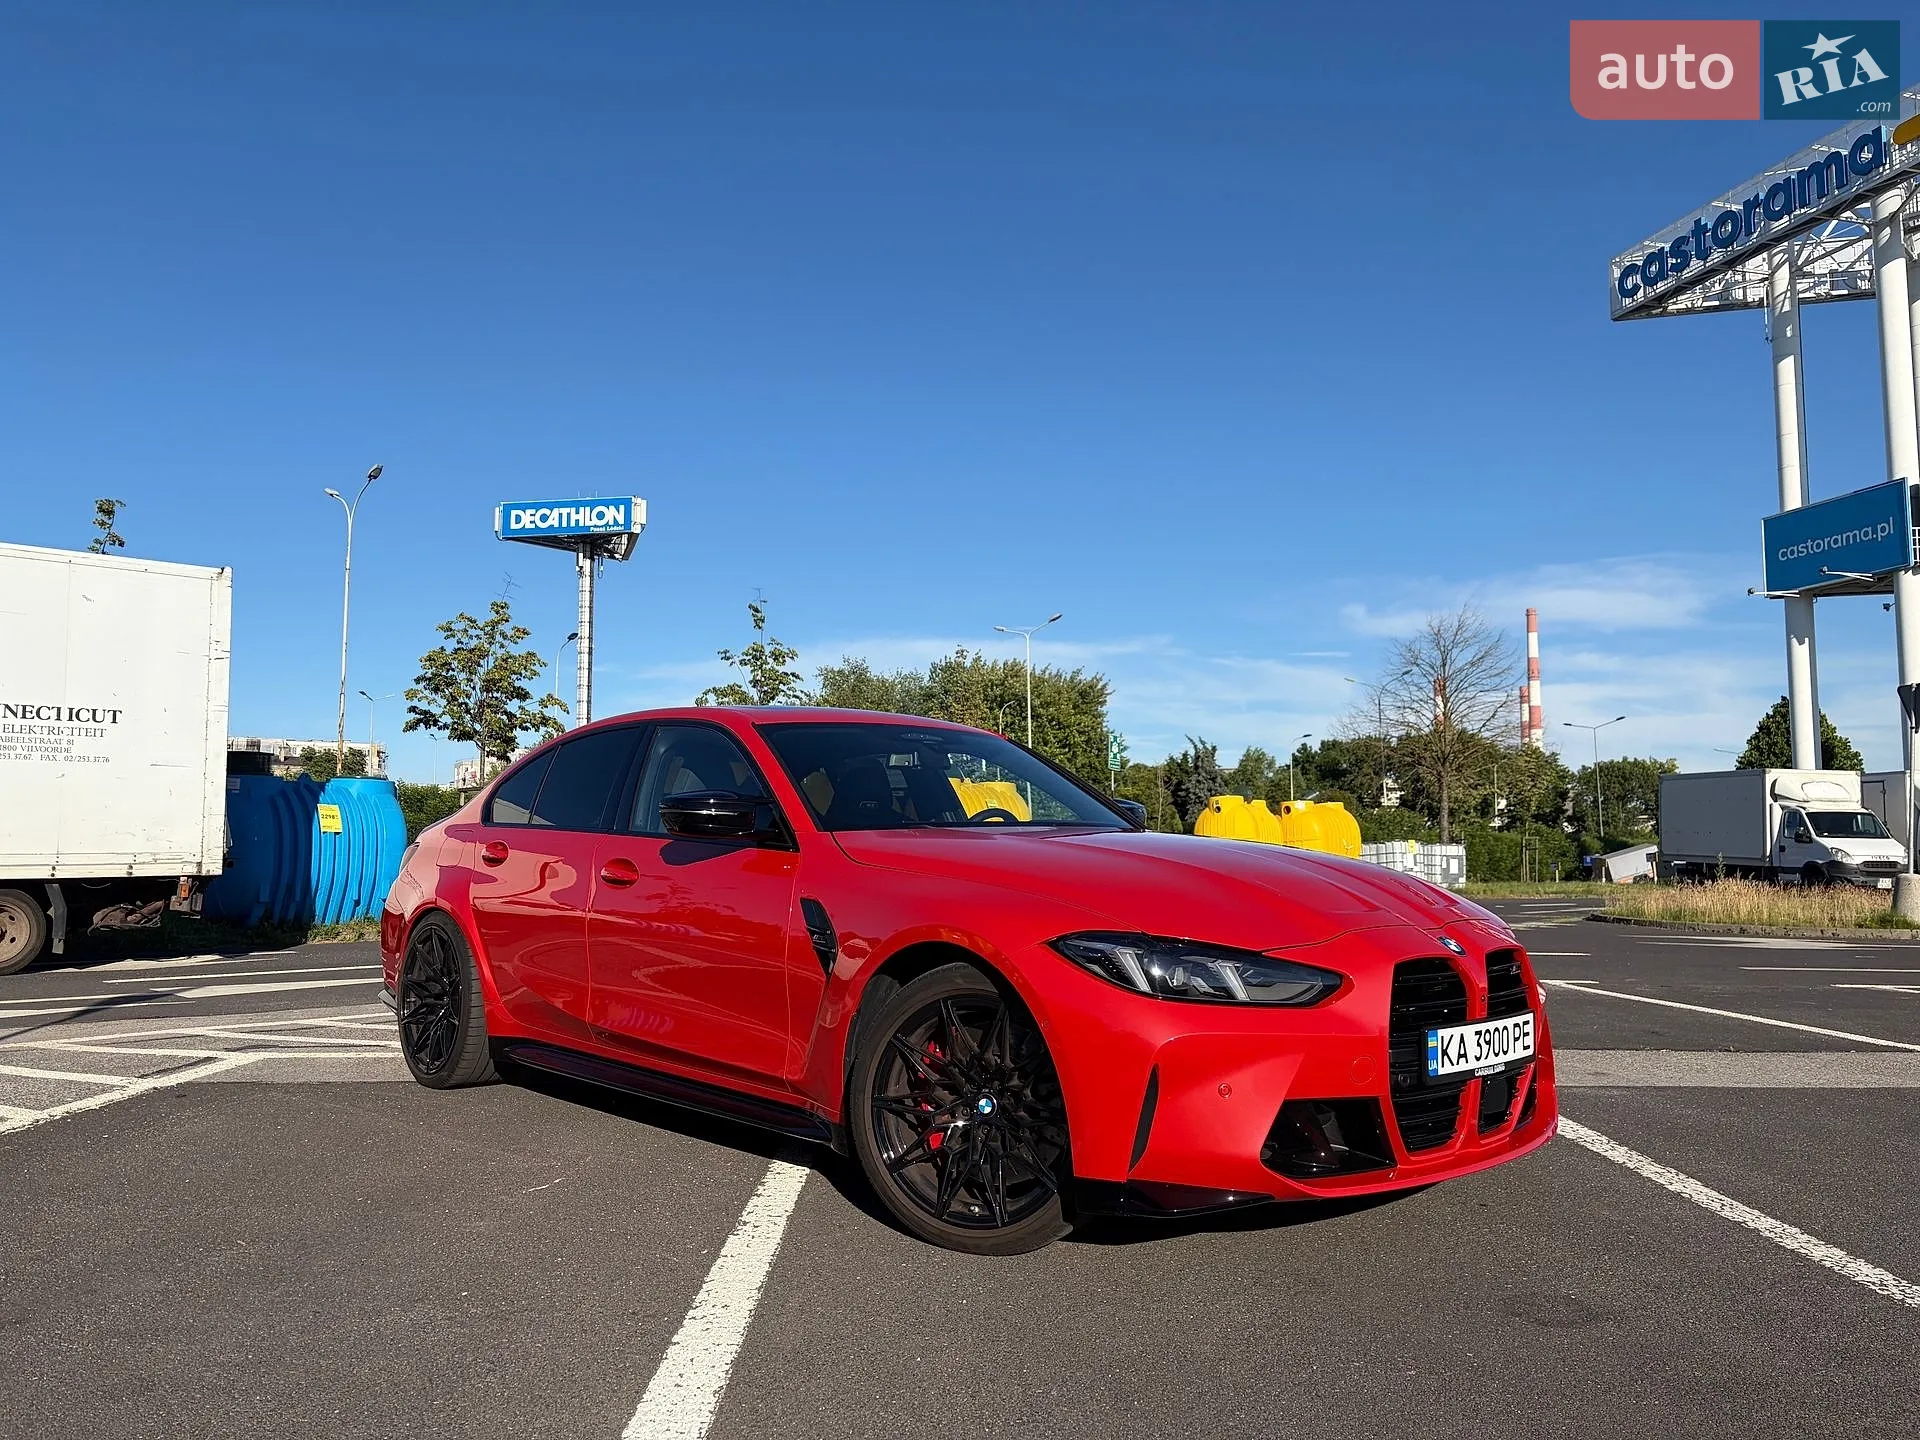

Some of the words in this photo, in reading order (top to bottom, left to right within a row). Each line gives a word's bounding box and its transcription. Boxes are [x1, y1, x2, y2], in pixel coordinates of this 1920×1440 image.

[1617, 124, 1887, 298] castorama
[510, 504, 625, 530] DECATHLON
[1778, 516, 1894, 562] castorama.pl
[0, 703, 122, 724] NECTICUT
[2, 724, 107, 737] ELEKTRICITEIT
[1474, 1025, 1509, 1062] 3900
[1428, 1060, 1438, 1071] UA
